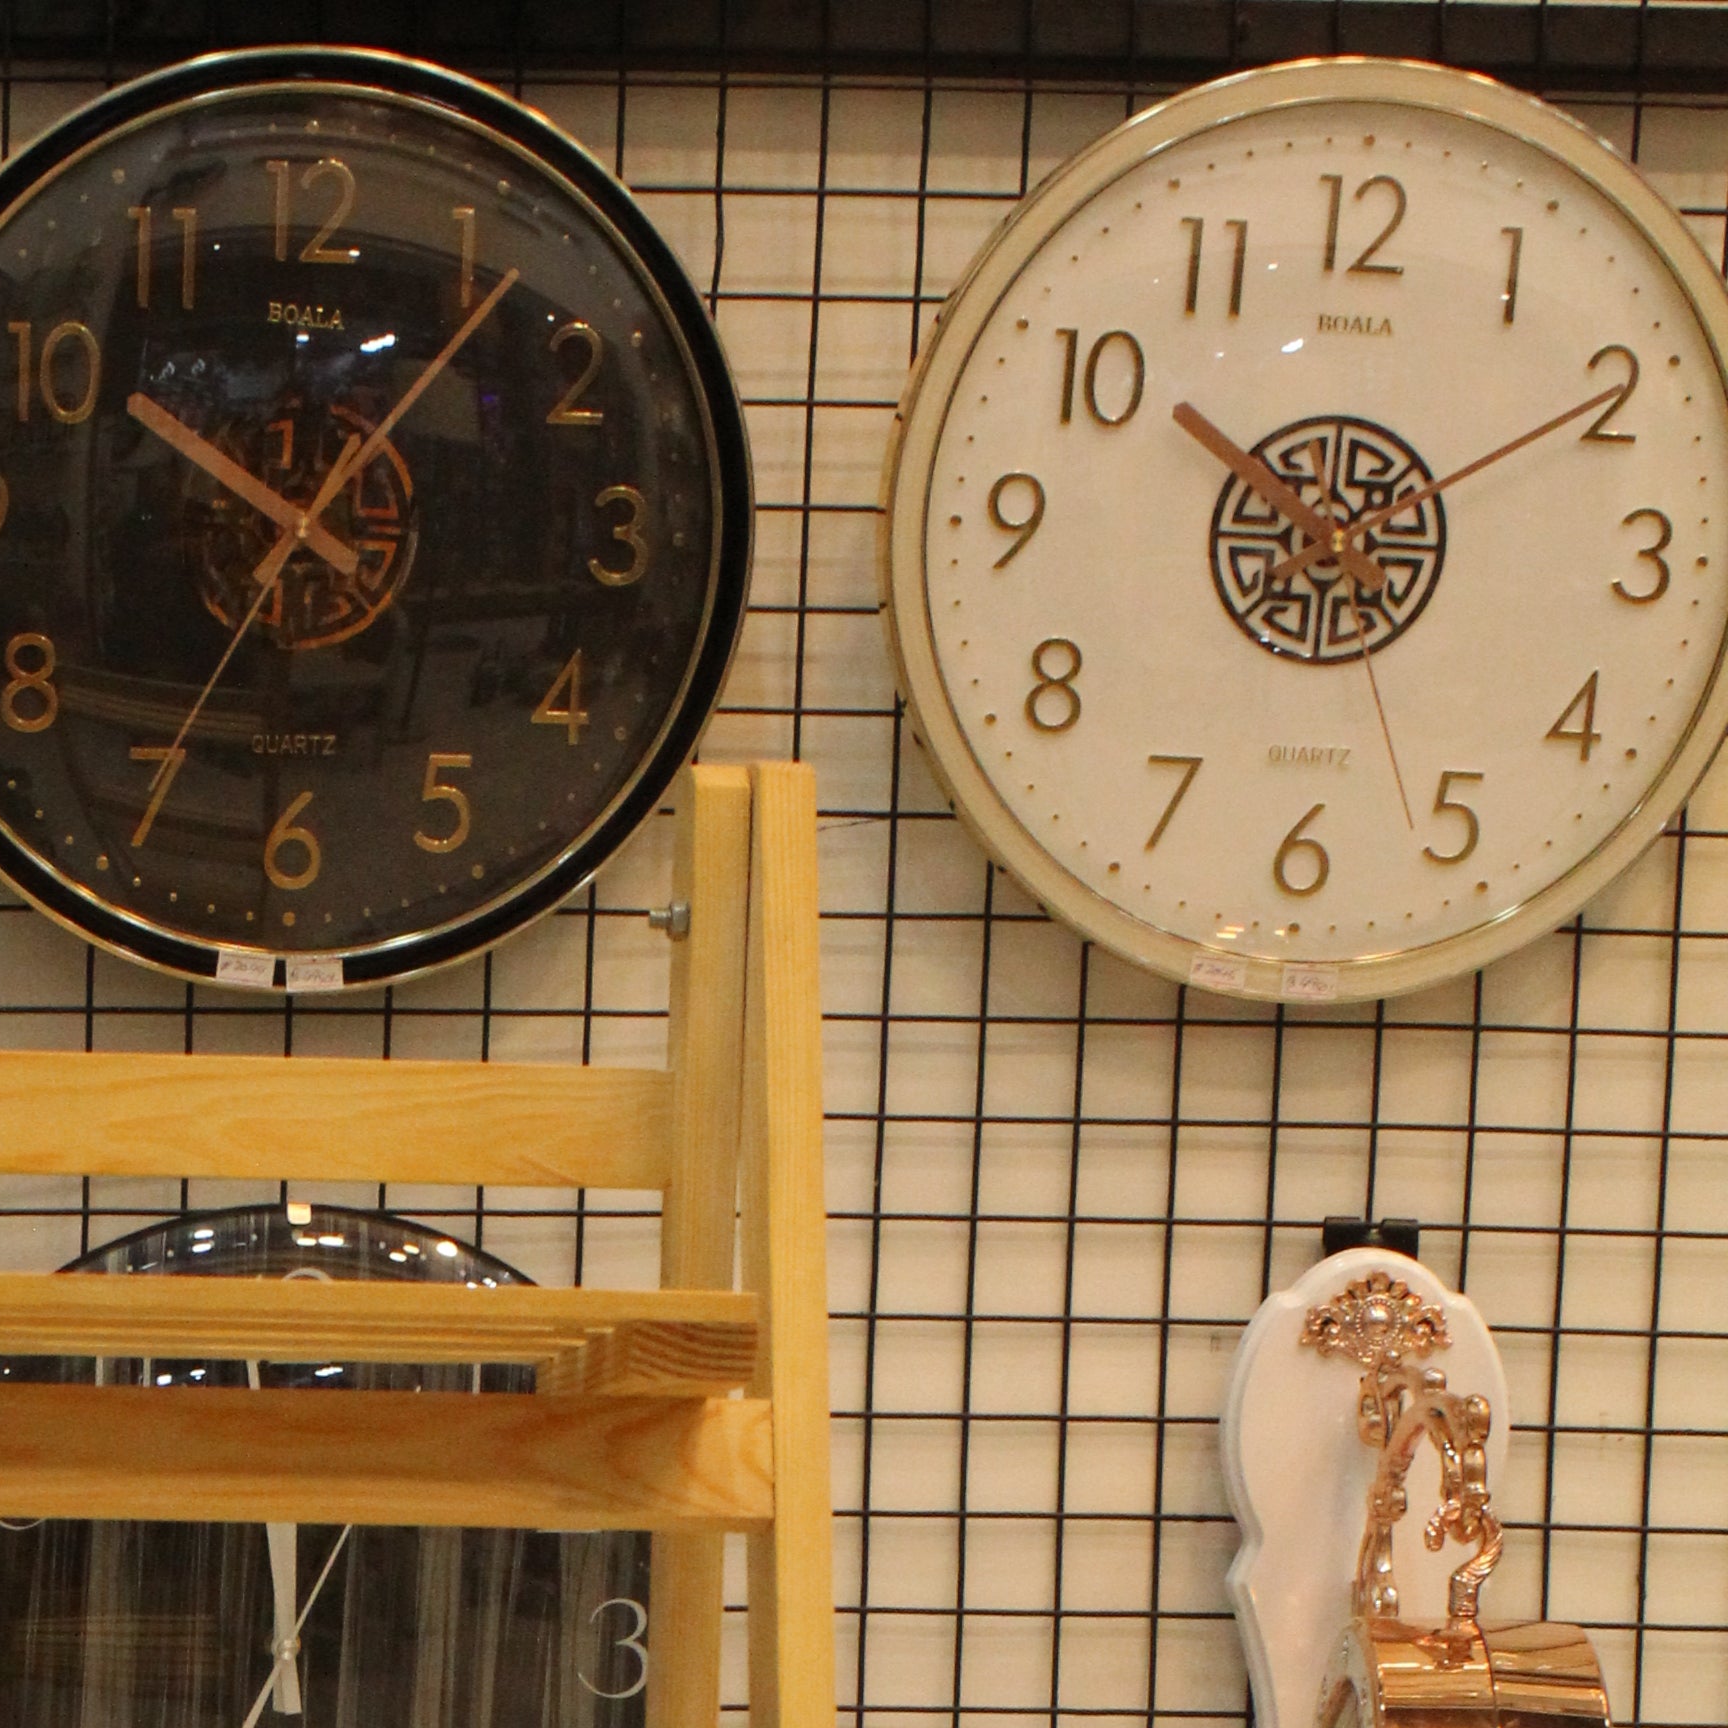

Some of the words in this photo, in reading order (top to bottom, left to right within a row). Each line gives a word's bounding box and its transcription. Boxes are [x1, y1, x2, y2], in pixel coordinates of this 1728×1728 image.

[127, 206, 198, 310] 11
[267, 159, 357, 264] 12
[451, 206, 476, 308] 1
[1319, 174, 1408, 276] 12
[267, 301, 346, 331] BOALA
[1181, 216, 1250, 317] 11
[1501, 227, 1524, 325] 1
[7, 321, 101, 425] 10
[546, 321, 604, 425] 2
[1317, 313, 1393, 337] BOALA
[1055, 327, 1146, 427] 10
[1579, 344, 1641, 443] 2
[588, 485, 647, 586] 3
[986, 470, 1046, 570] 9
[1611, 508, 1674, 605] 3
[0, 632, 59, 733] 8
[531, 649, 590, 746] 4
[1024, 637, 1083, 733] 8
[1545, 670, 1602, 762] 4
[251, 734, 337, 757] QUARTZ
[1267, 744, 1352, 768] QUARTZ
[129, 747, 186, 847] 7
[263, 790, 322, 891] 6
[413, 752, 473, 854] 5
[1144, 753, 1204, 851] 7
[1422, 770, 1485, 864] 5
[1274, 803, 1330, 897] 6
[577, 1598, 650, 1700] 3
